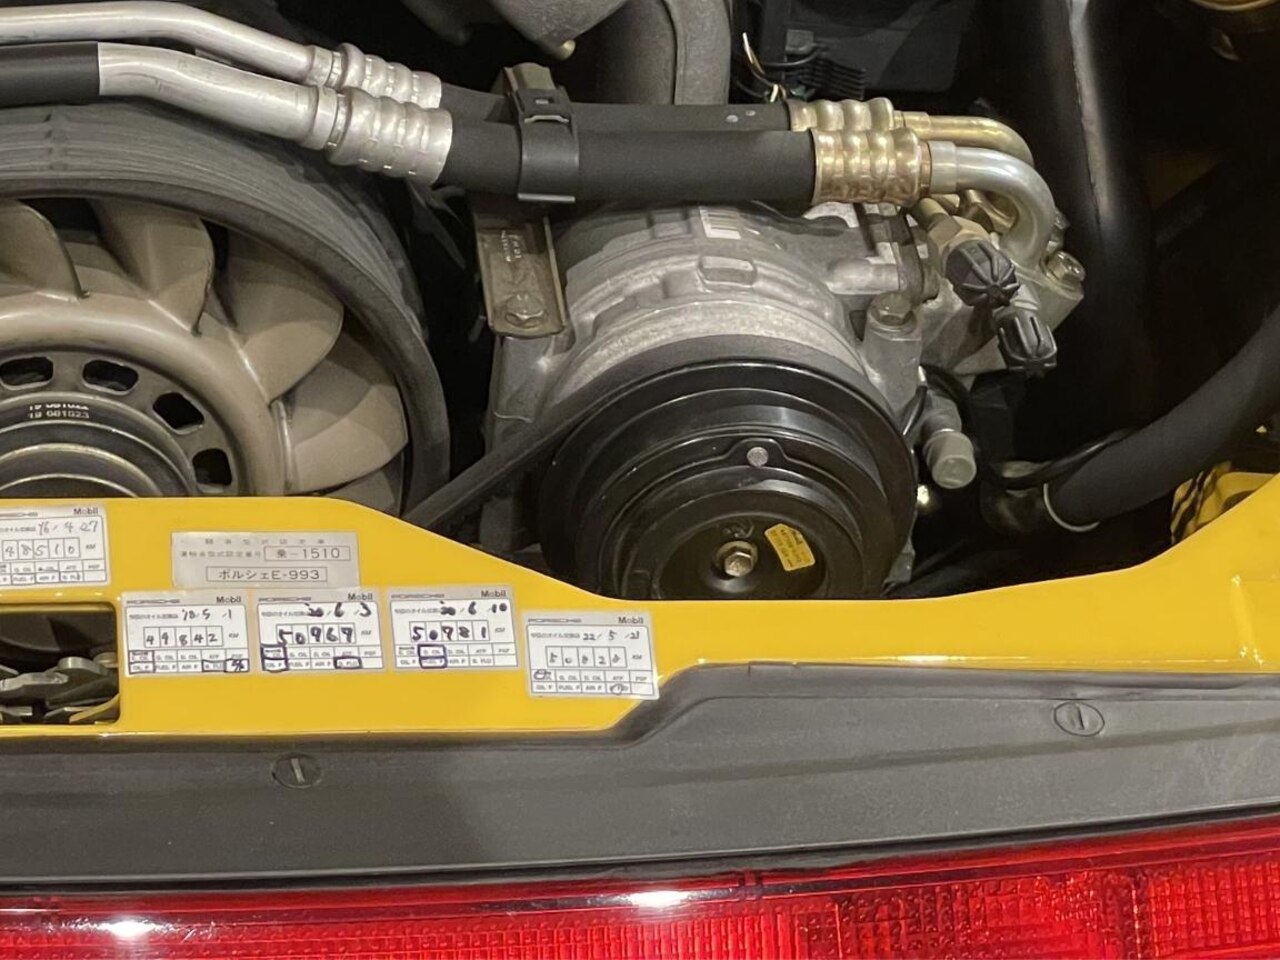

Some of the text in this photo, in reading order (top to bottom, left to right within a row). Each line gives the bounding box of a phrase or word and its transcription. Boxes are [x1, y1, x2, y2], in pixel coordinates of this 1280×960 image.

[65, 521, 74, 534] 4
[481, 590, 507, 598] Mobil
[202, 608, 211, 620] 5
[334, 602, 372, 618] 6 3
[467, 601, 477, 616] 6
[582, 633, 597, 641] 22
[607, 630, 617, 641] 5
